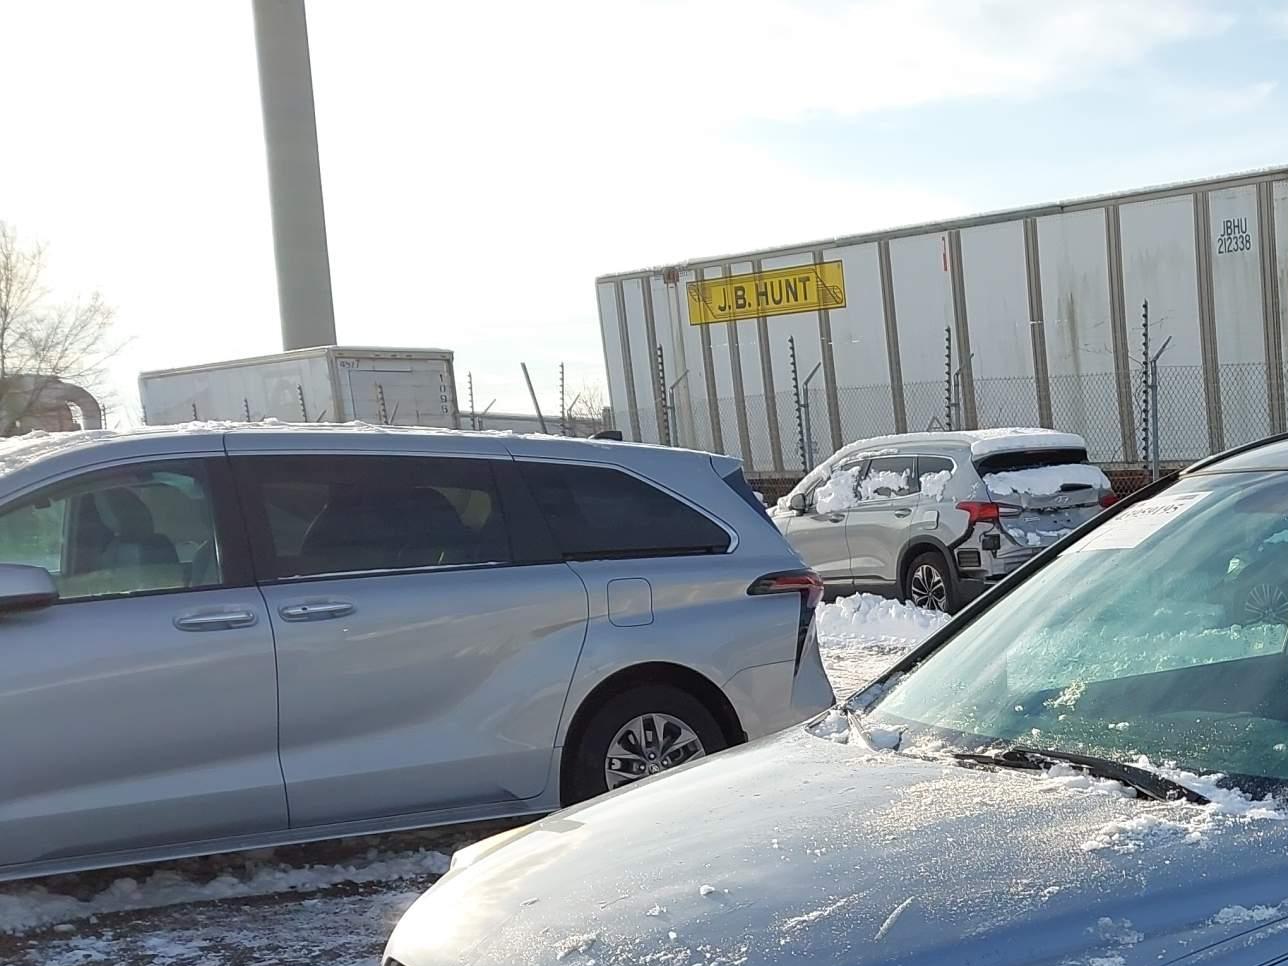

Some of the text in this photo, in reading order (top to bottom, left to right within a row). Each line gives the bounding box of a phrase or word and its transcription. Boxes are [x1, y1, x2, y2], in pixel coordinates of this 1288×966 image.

[1220, 217, 1248, 237] JBHU
[1217, 233, 1251, 254] 212338
[718, 276, 810, 312] J.B. HUNT
